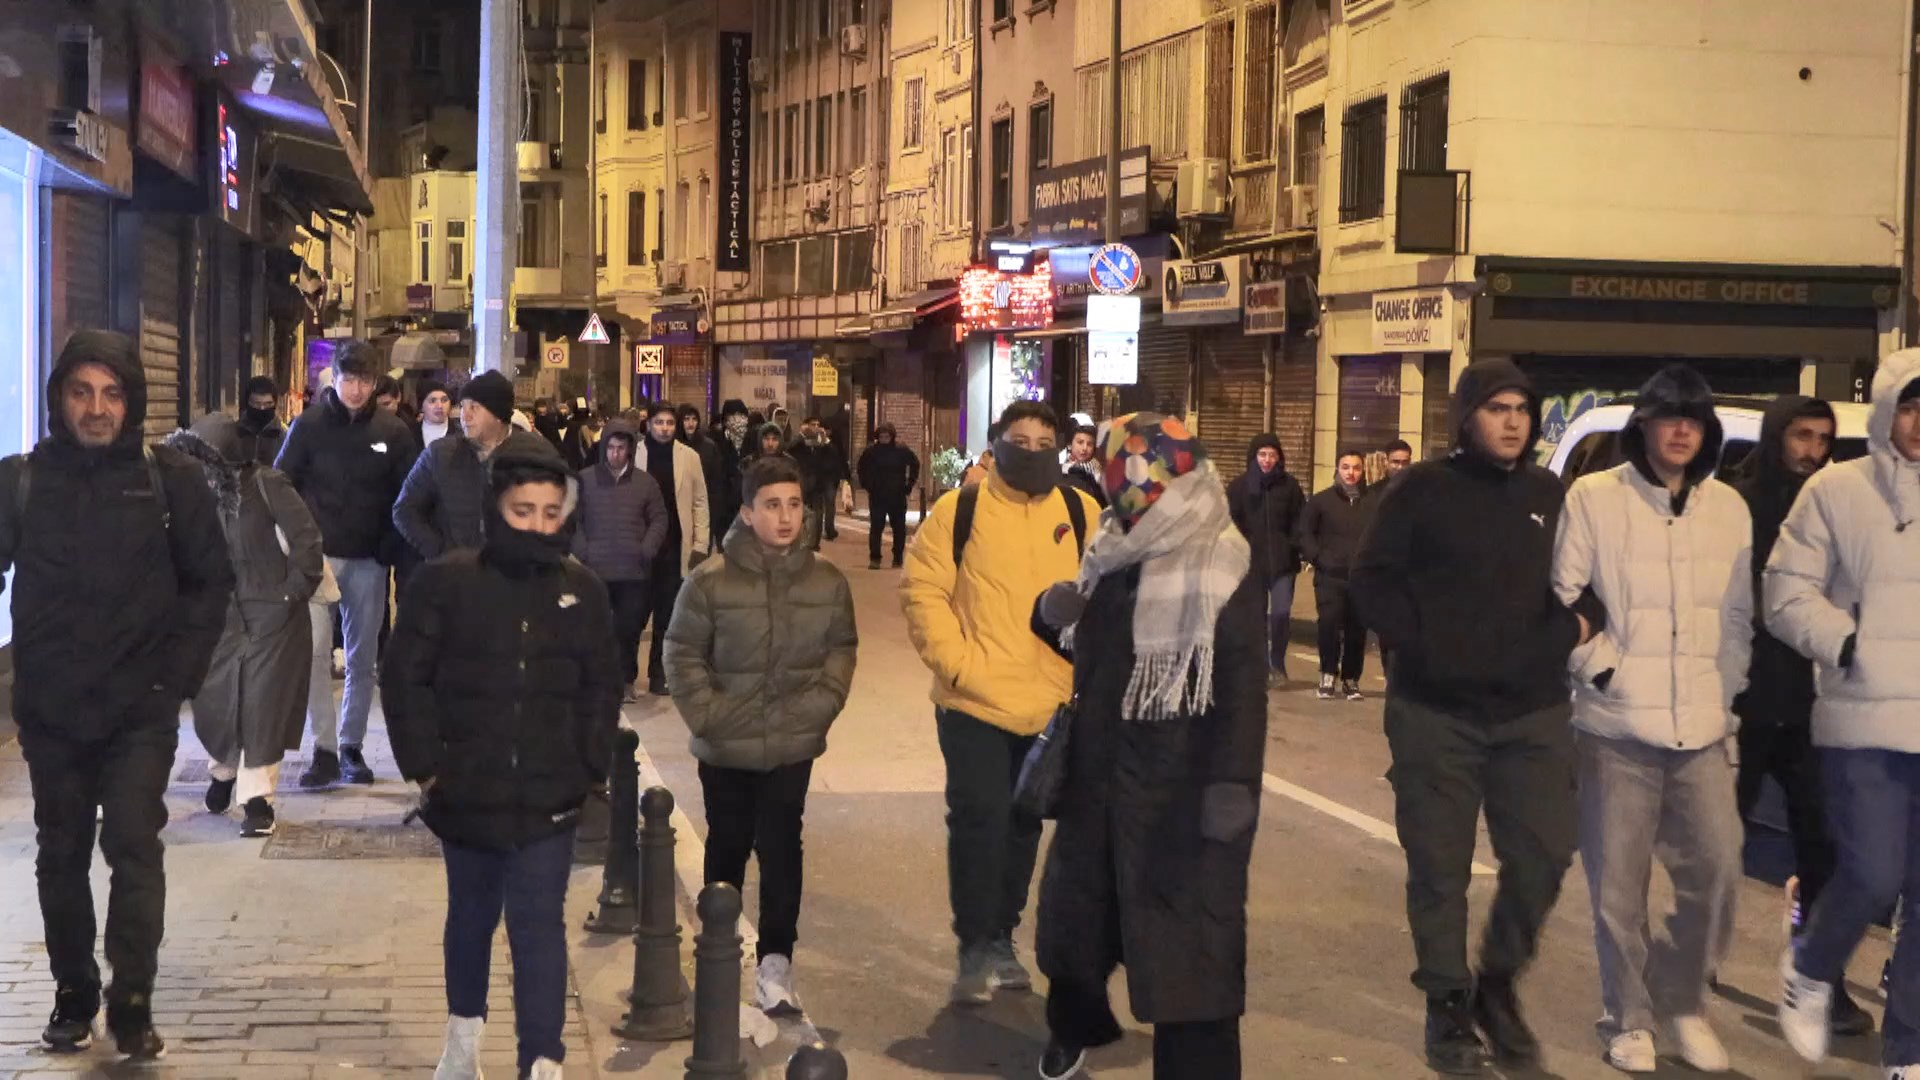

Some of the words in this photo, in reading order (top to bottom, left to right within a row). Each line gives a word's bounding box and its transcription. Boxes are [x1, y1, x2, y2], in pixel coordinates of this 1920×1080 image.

[731, 37, 743, 116] MILITARY
[731, 119, 742, 177] POLICE
[729, 181, 740, 258] TACTICAL
[1375, 298, 1411, 322] CHANGE
[1412, 295, 1443, 320] OFFICE
[1570, 275, 1707, 300] EXCHANGE
[1720, 280, 1809, 304] OFFICE
